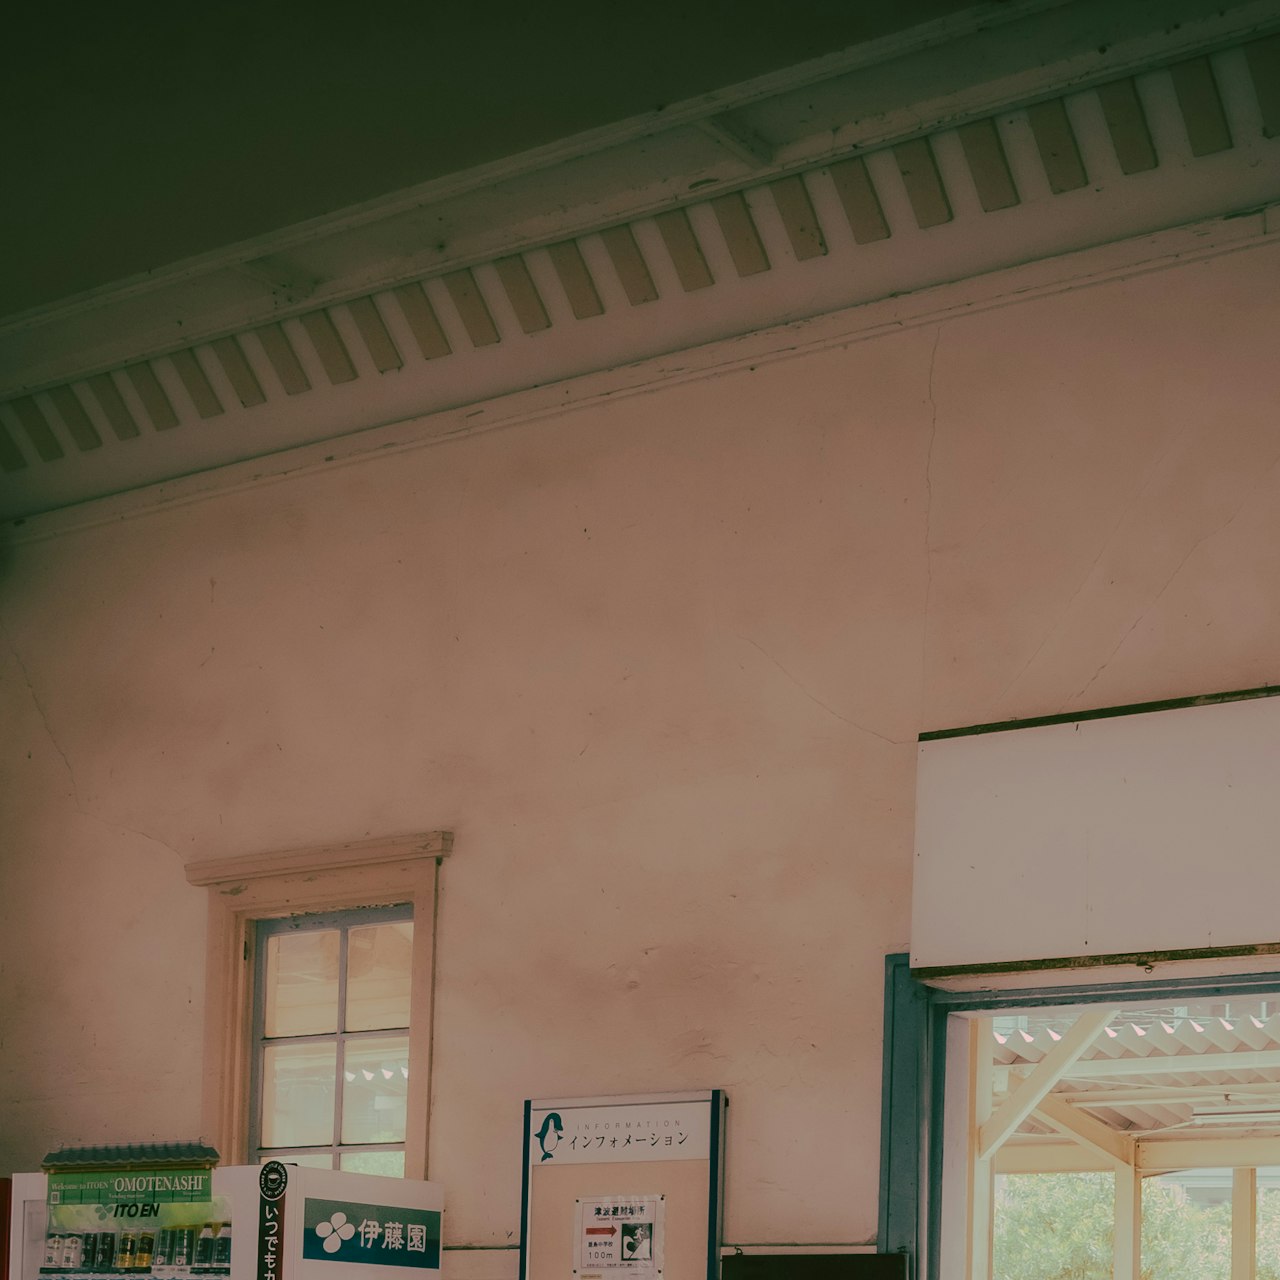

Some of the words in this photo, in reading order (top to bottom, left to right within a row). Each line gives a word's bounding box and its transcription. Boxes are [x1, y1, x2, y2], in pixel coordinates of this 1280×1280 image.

[577, 1120, 680, 1130] INFORMATION
[569, 1132, 689, 1150] インフォメーション
[358, 1219, 427, 1252] 伊藤園
